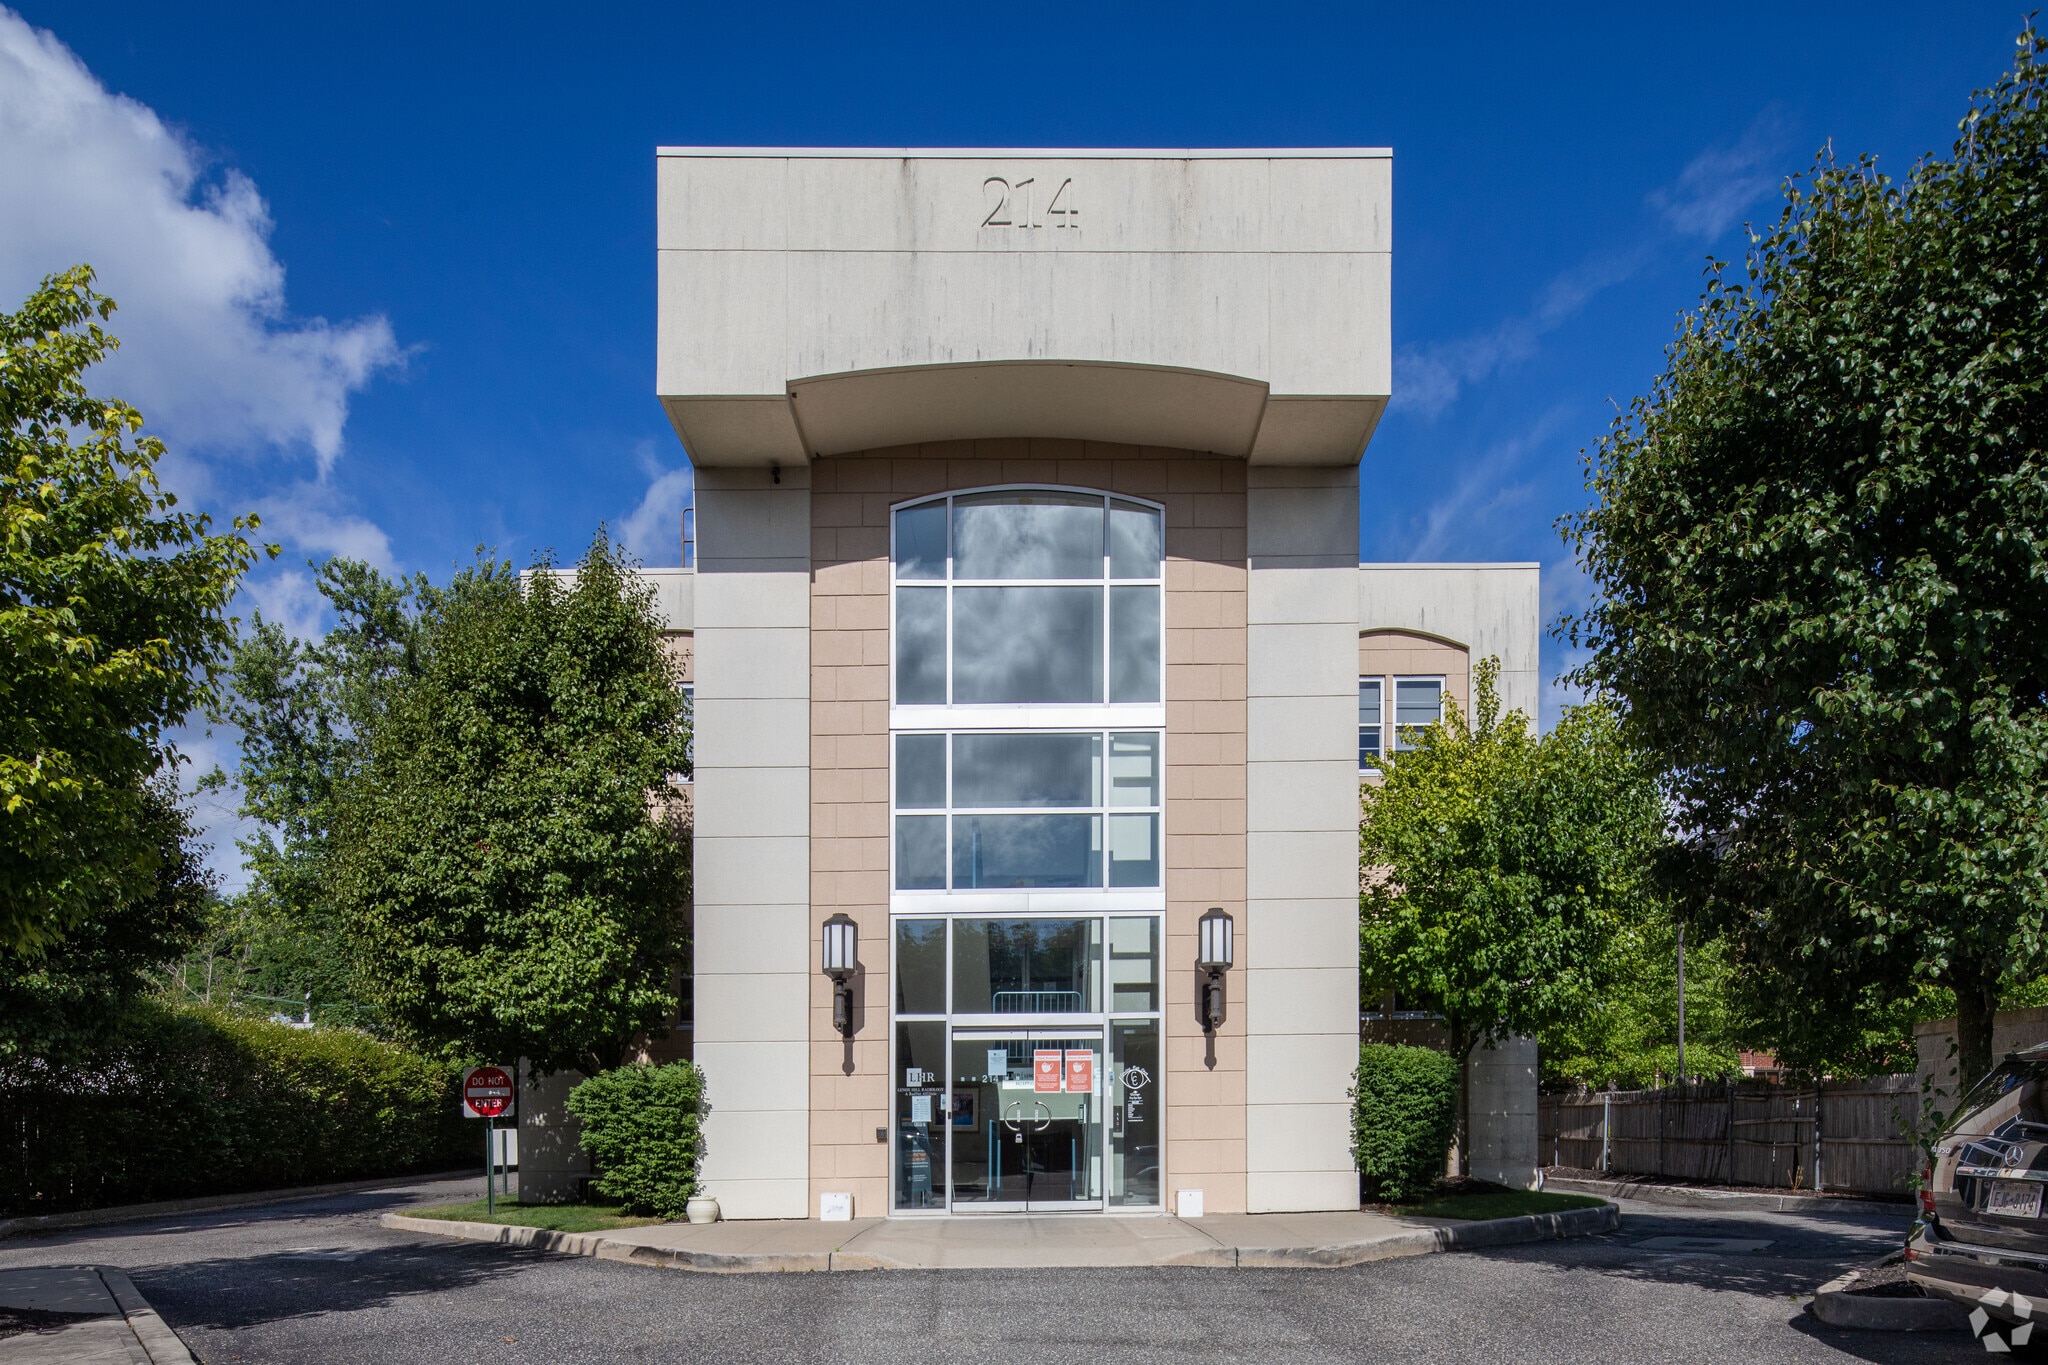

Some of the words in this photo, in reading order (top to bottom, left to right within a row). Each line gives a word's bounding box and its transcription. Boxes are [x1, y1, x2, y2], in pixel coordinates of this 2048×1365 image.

[981, 176, 1079, 228] 214
[472, 1077, 484, 1086] DO
[488, 1076, 505, 1085] NOT
[909, 1072, 936, 1083] LHR
[982, 1074, 999, 1083] 214
[475, 1099, 503, 1108] ENTER
